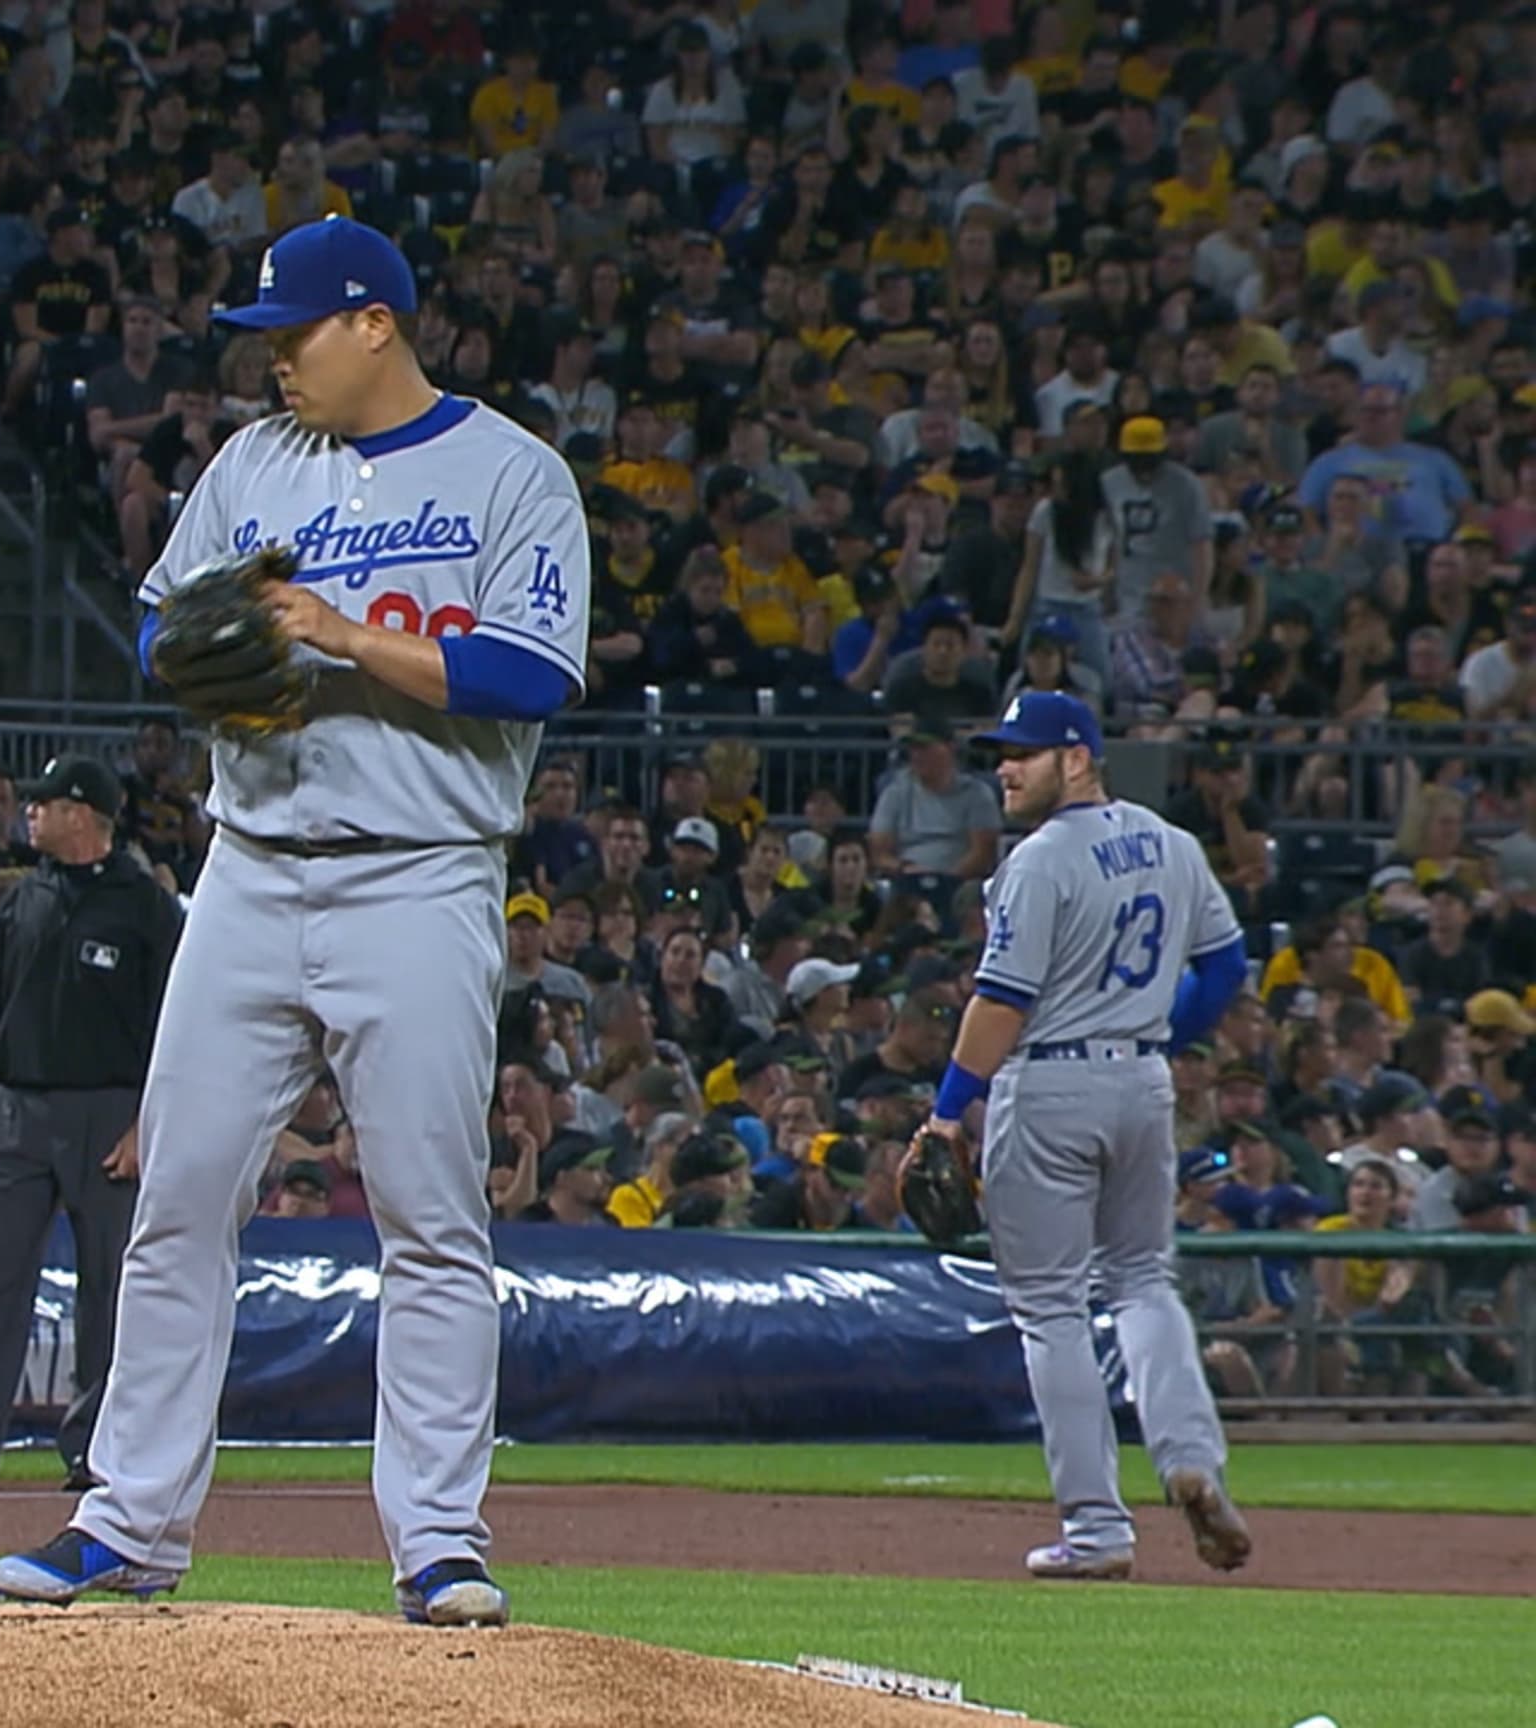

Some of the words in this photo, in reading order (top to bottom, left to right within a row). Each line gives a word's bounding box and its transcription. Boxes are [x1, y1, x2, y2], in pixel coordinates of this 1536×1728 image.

[293, 499, 476, 590] Angeles
[527, 545, 567, 617] LA
[1091, 830, 1164, 881] MUNCY
[1097, 893, 1164, 992] 13
